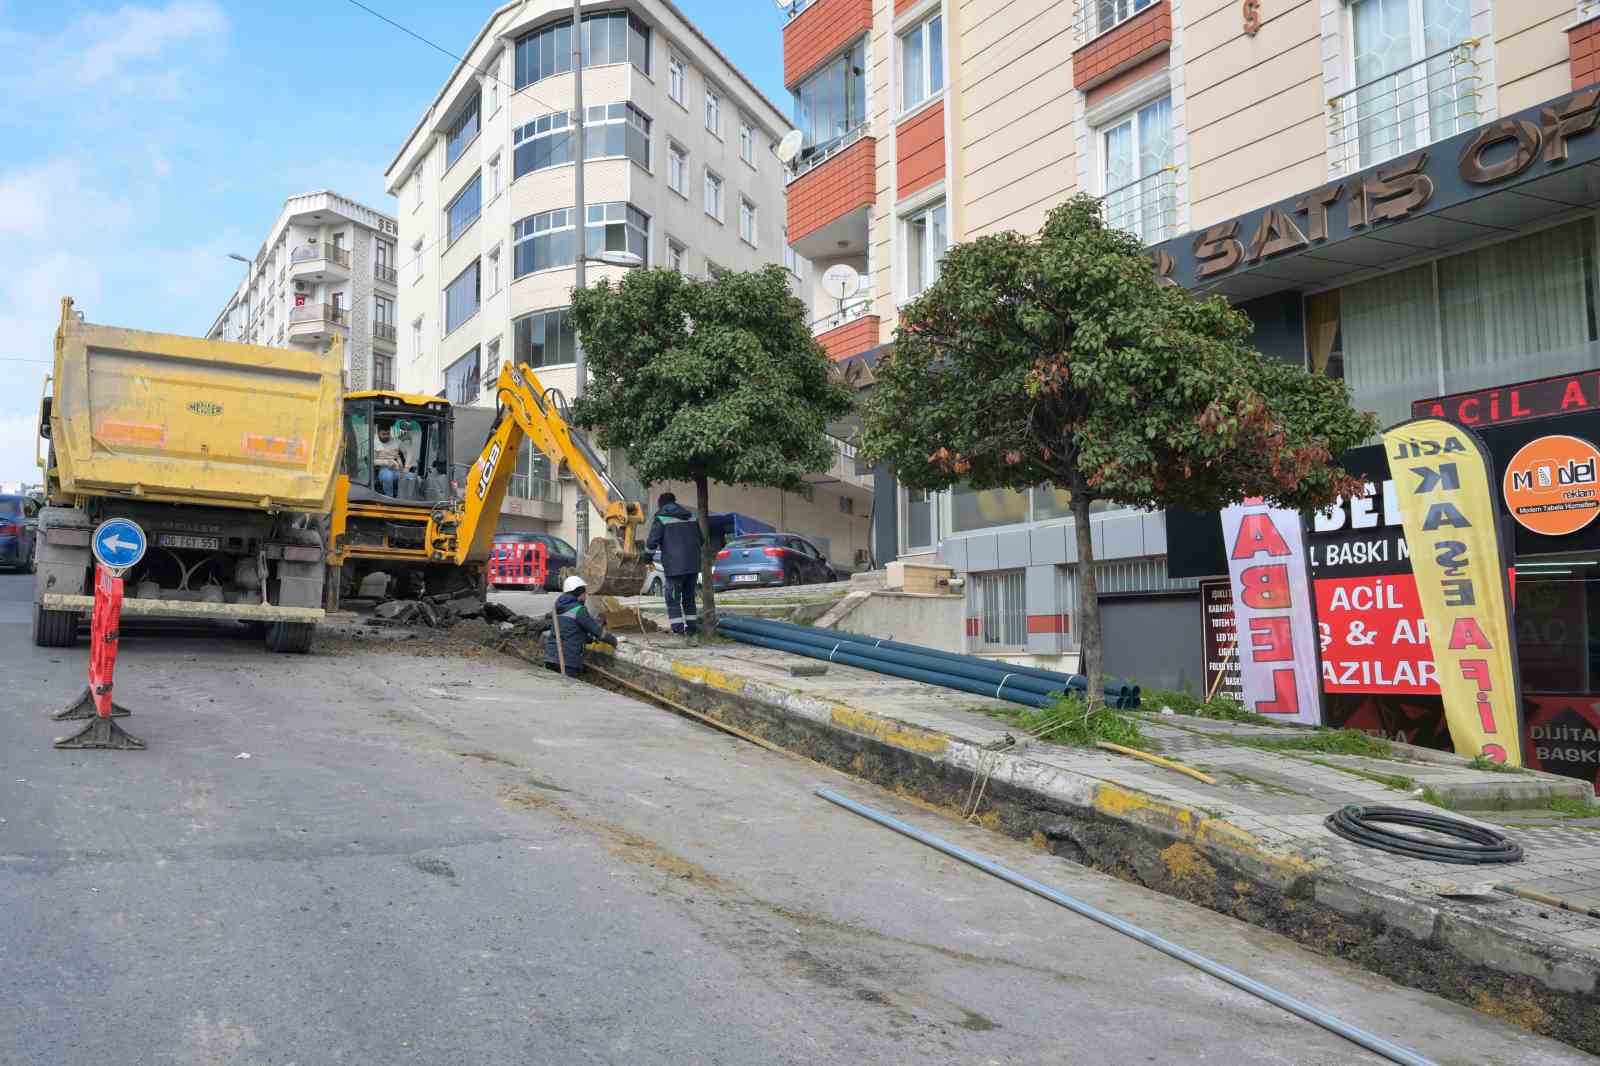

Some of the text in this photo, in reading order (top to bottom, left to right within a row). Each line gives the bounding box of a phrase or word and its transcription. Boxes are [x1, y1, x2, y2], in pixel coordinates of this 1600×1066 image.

[478, 441, 501, 500] JCB
[1326, 539, 1388, 567] BASKI
[1329, 580, 1404, 612] ACİL
[1346, 620, 1377, 646] &
[1530, 724, 1600, 742] DİJİTA
